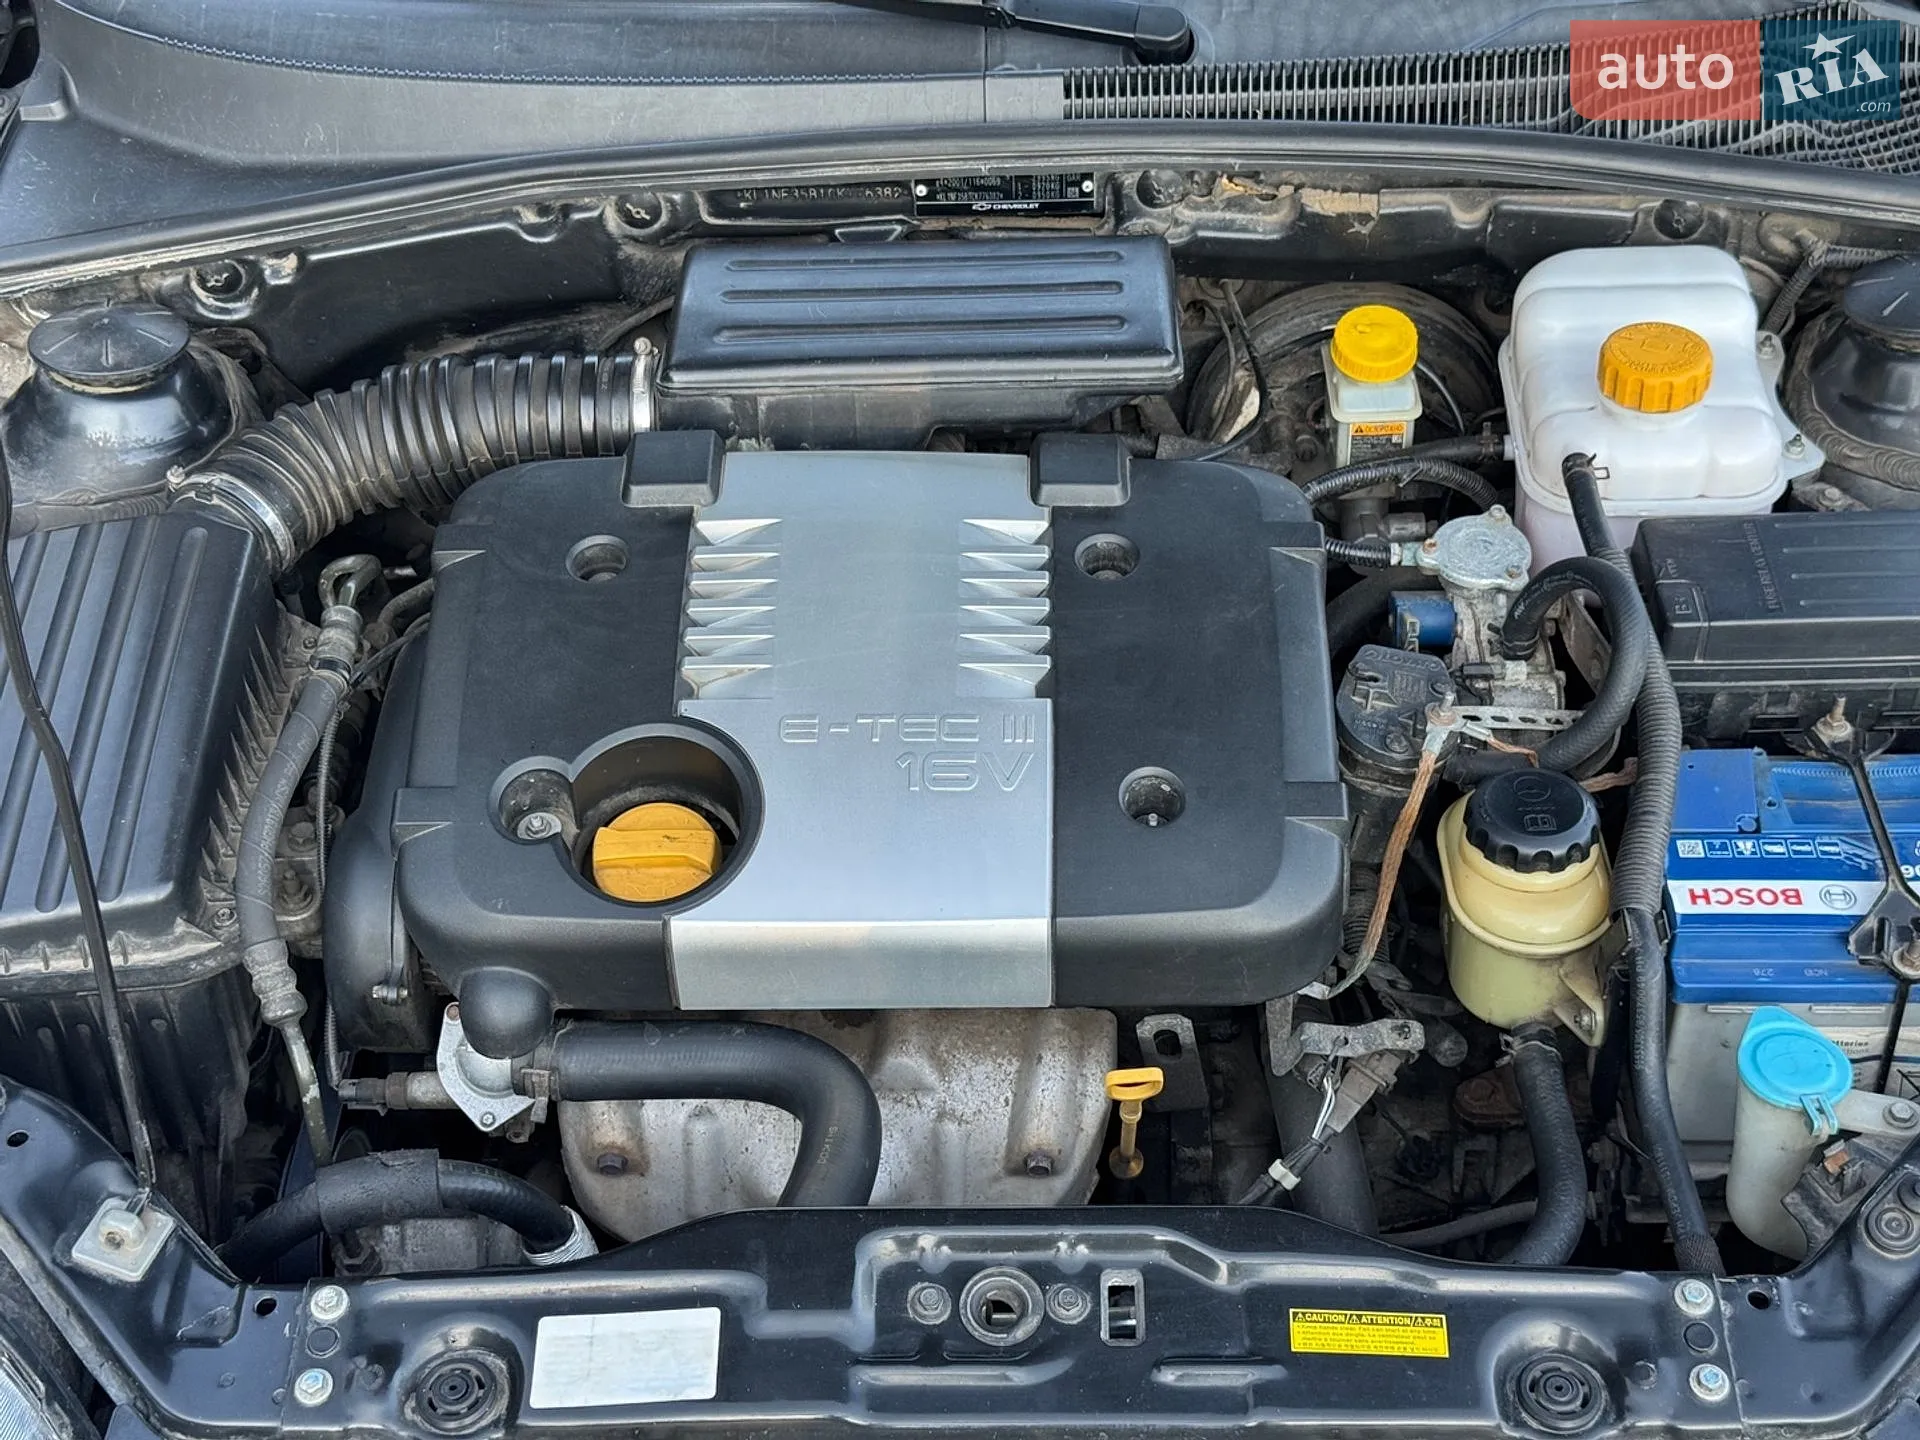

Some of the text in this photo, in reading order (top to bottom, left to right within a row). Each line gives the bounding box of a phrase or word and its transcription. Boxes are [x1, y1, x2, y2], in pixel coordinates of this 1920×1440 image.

[992, 202, 1039, 210] CHEVROLET
[778, 712, 981, 744] E-TEC
[895, 750, 1035, 792] 16V
[1687, 887, 1804, 906] BOSCH
[1305, 1313, 1411, 1325] CAUTION ATTENTION
